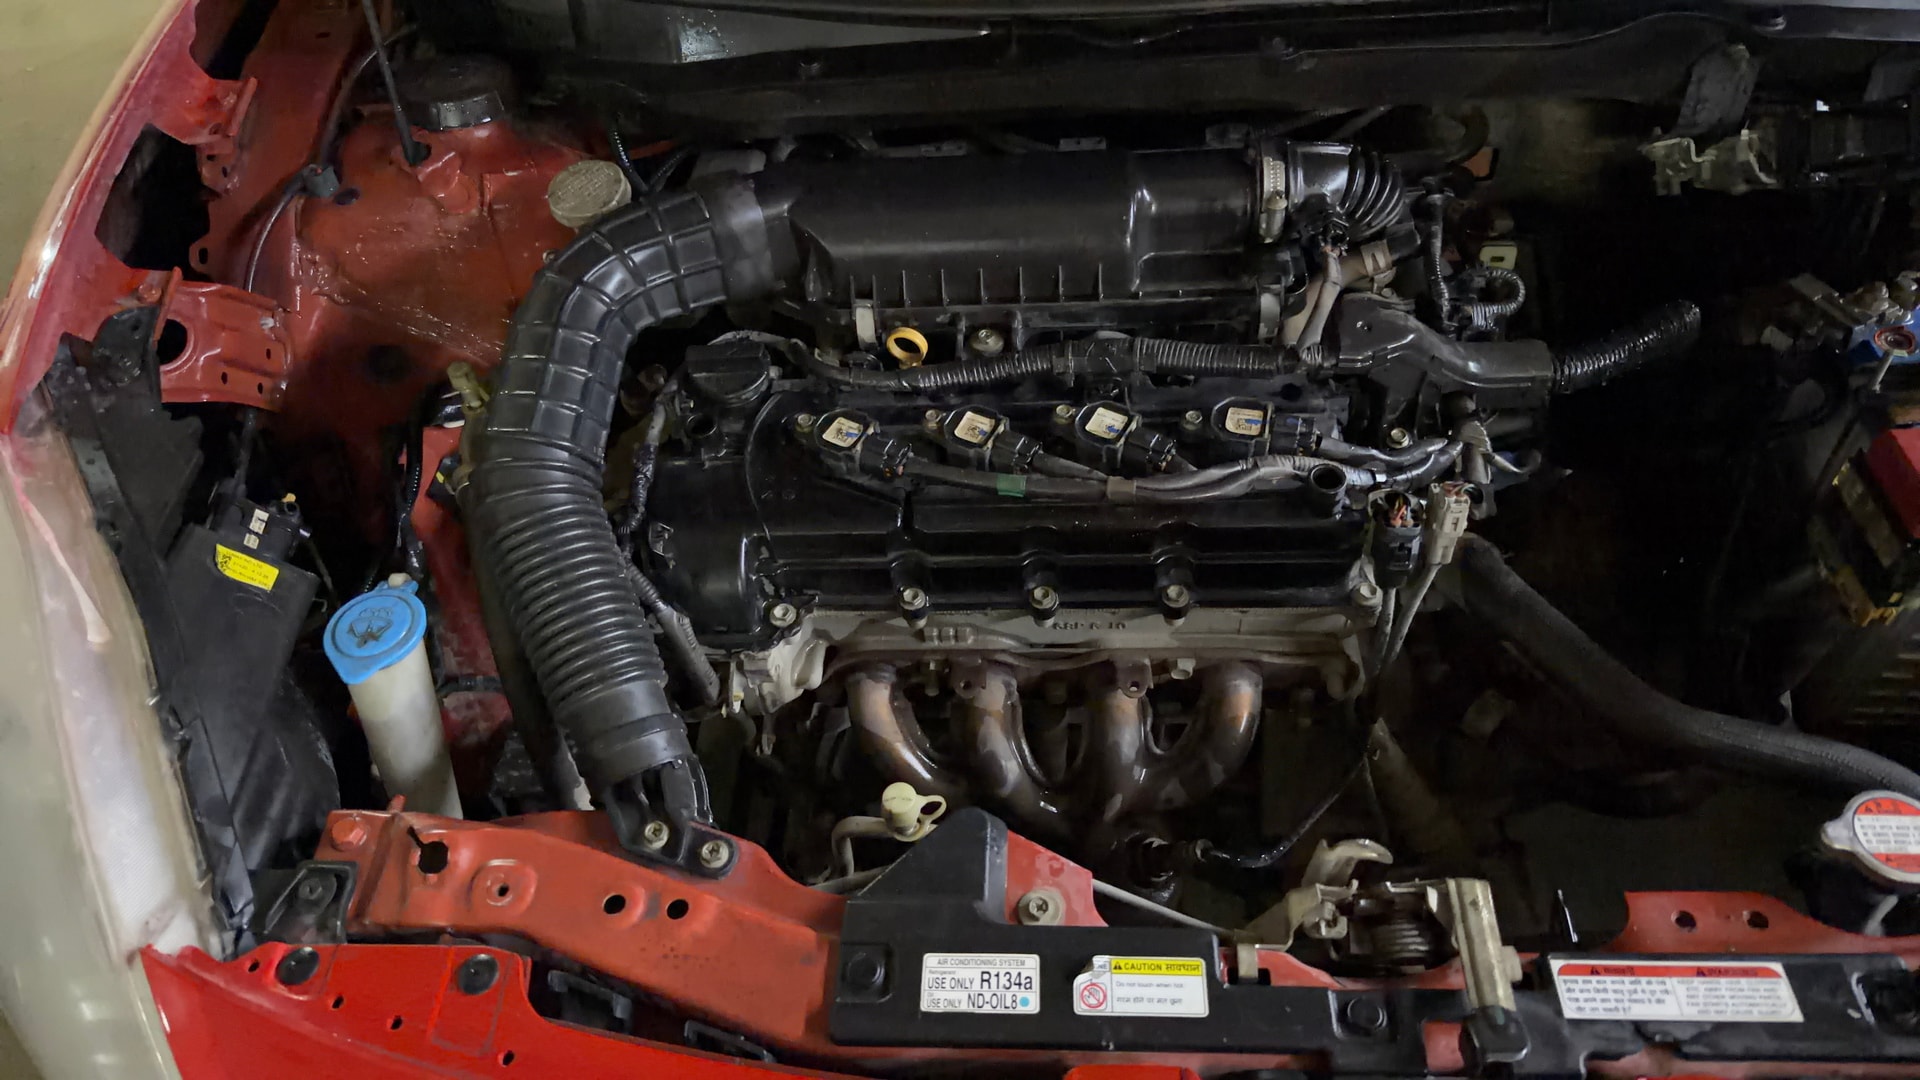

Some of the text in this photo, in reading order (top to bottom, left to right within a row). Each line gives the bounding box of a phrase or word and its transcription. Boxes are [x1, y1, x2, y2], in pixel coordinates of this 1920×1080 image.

[937, 958, 1026, 967] AIR CONDITIONING SYSTEM
[1123, 962, 1163, 971] CAUTION
[927, 971, 1033, 990] USE ONLY R134a
[926, 993, 1018, 1010] USE ONLY ND-OIL8
